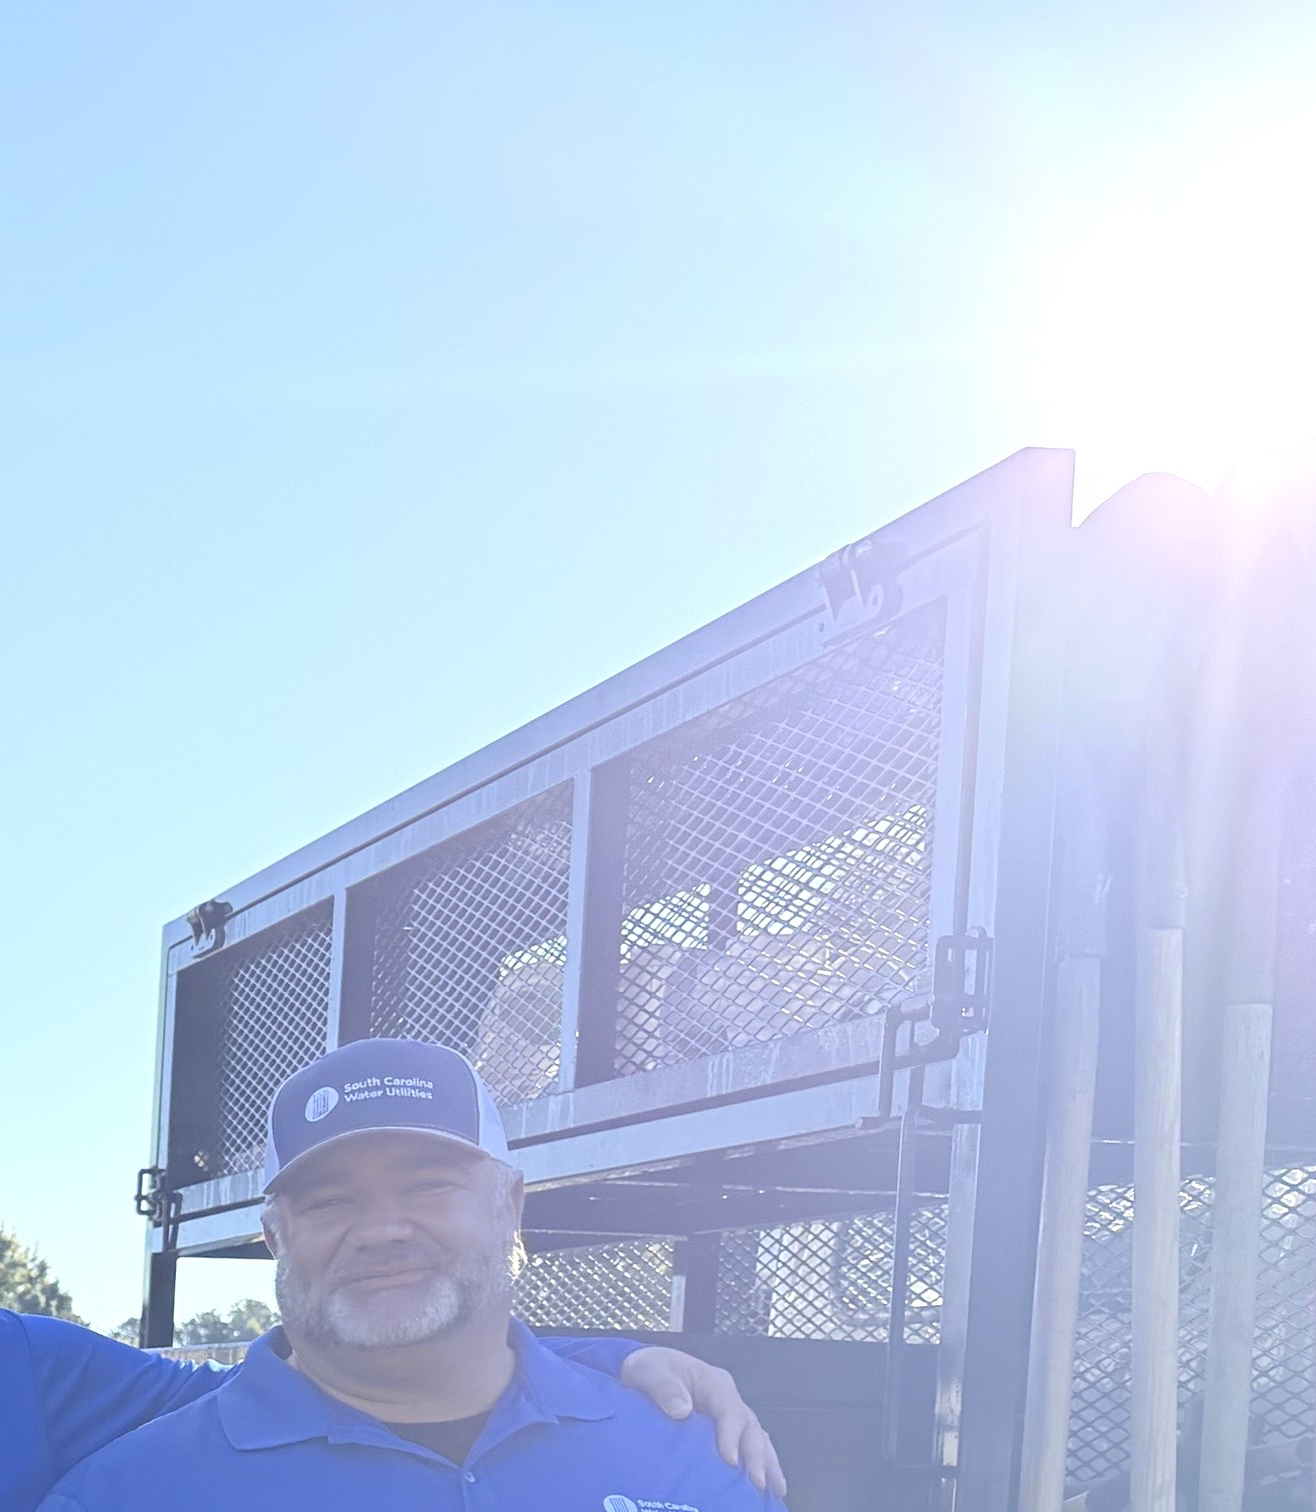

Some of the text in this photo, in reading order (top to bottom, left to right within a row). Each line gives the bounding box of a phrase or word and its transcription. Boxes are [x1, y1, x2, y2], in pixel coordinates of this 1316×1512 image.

[344, 1077, 434, 1093] South Carolina
[344, 1087, 433, 1102] Water Utilities
